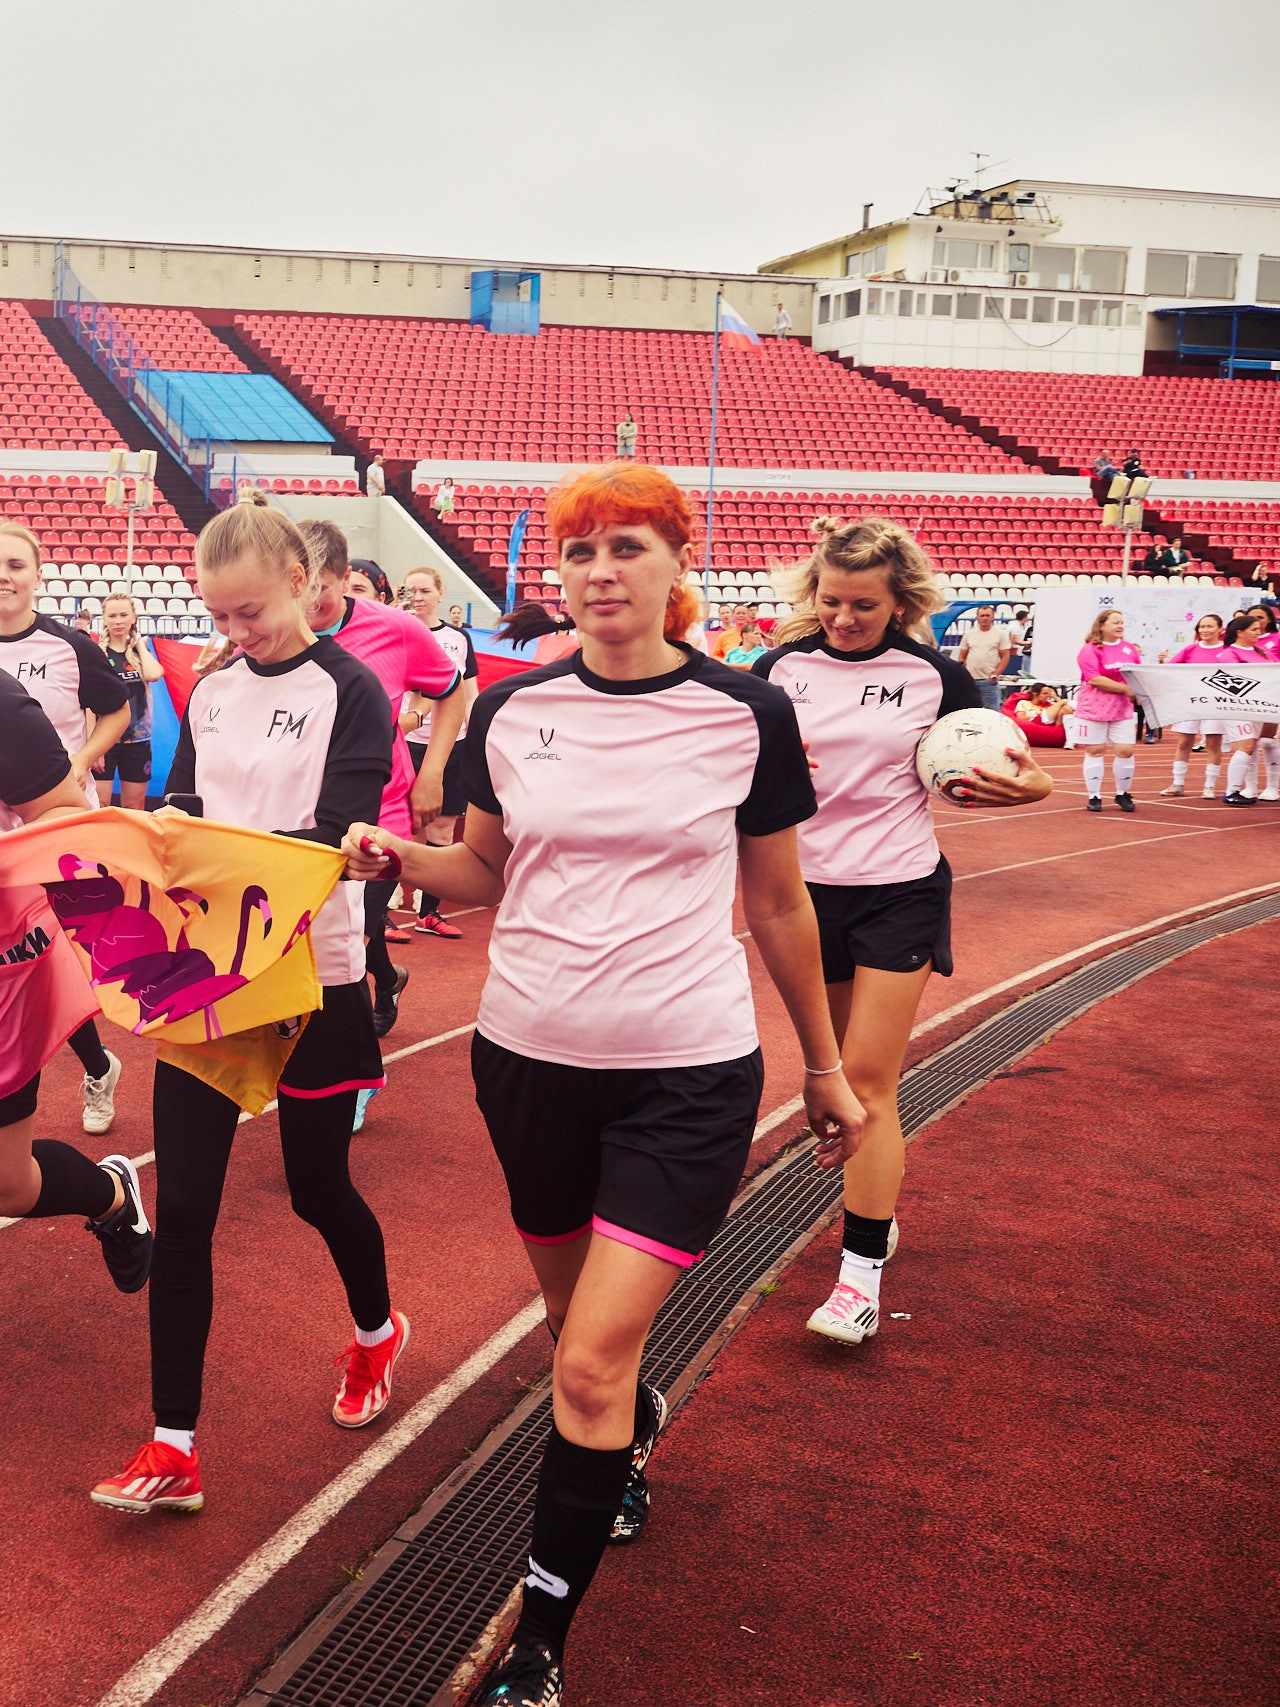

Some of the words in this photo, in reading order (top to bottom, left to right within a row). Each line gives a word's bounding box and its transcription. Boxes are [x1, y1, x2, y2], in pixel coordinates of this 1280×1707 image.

[16, 661, 47, 680] FM
[860, 684, 906, 709] FM
[1190, 696, 1208, 704] FC
[267, 708, 310, 740] FM
[1236, 723, 1253, 736] 10
[1078, 725, 1088, 737] 11
[524, 751, 562, 761] JÖGEL
[830, 1320, 861, 1333] F50
